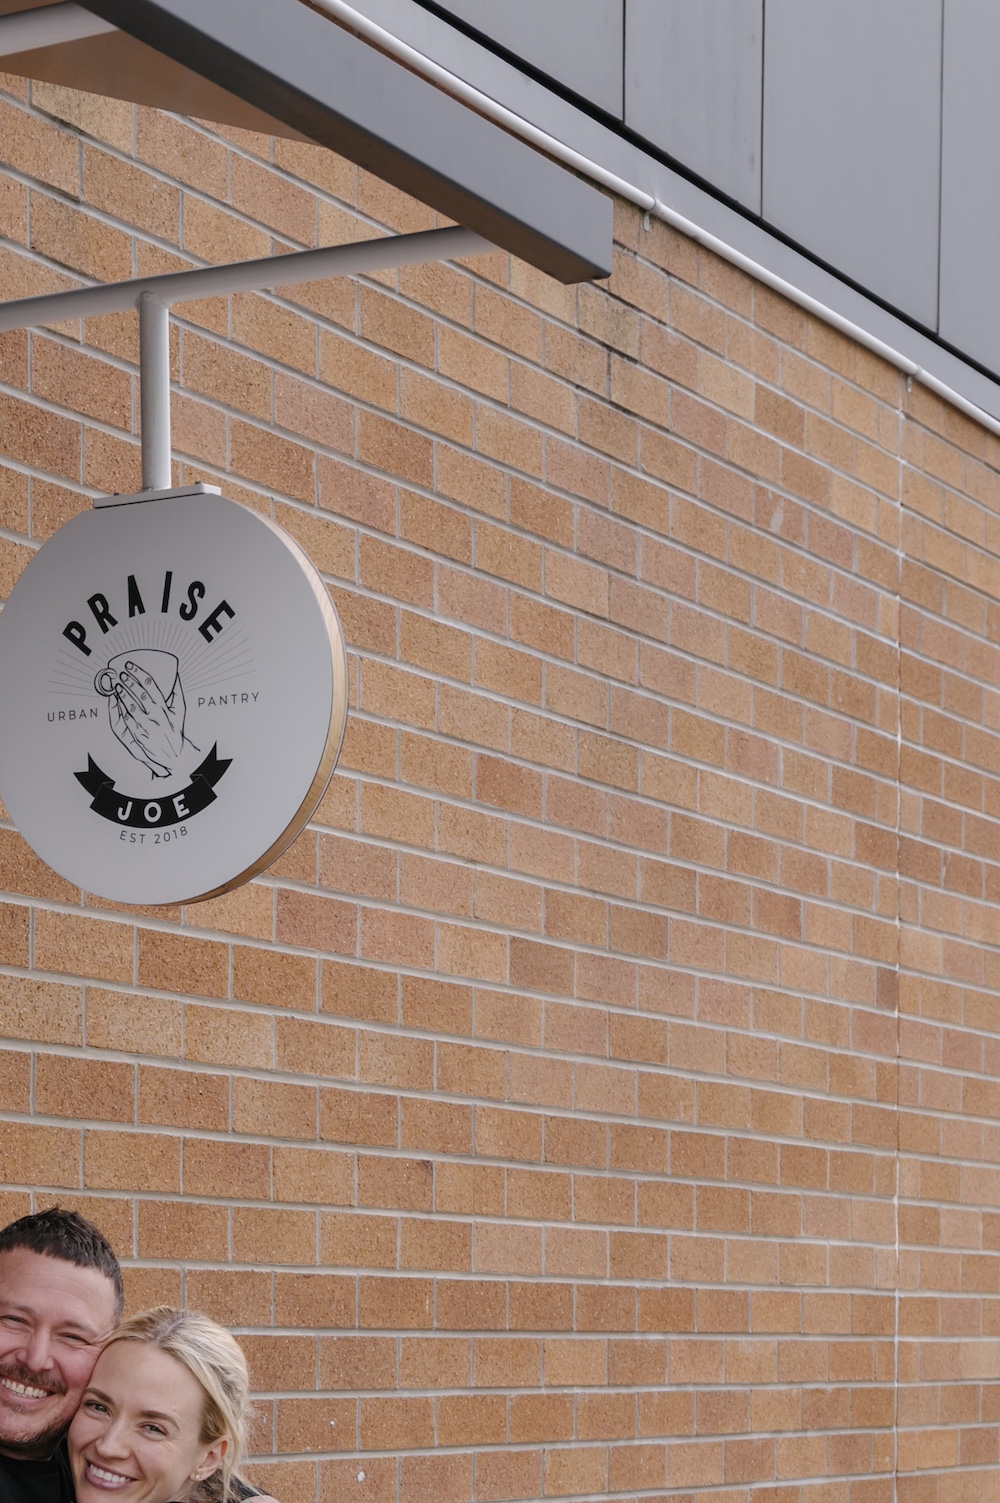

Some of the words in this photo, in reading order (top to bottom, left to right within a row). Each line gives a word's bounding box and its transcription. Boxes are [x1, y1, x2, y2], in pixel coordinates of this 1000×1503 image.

[62, 571, 236, 656] PRAISE
[47, 707, 99, 723] URBAN
[198, 692, 260, 708] PANTRY
[118, 793, 190, 823] JOE
[119, 830, 146, 844] EST
[154, 825, 189, 844] 2018
